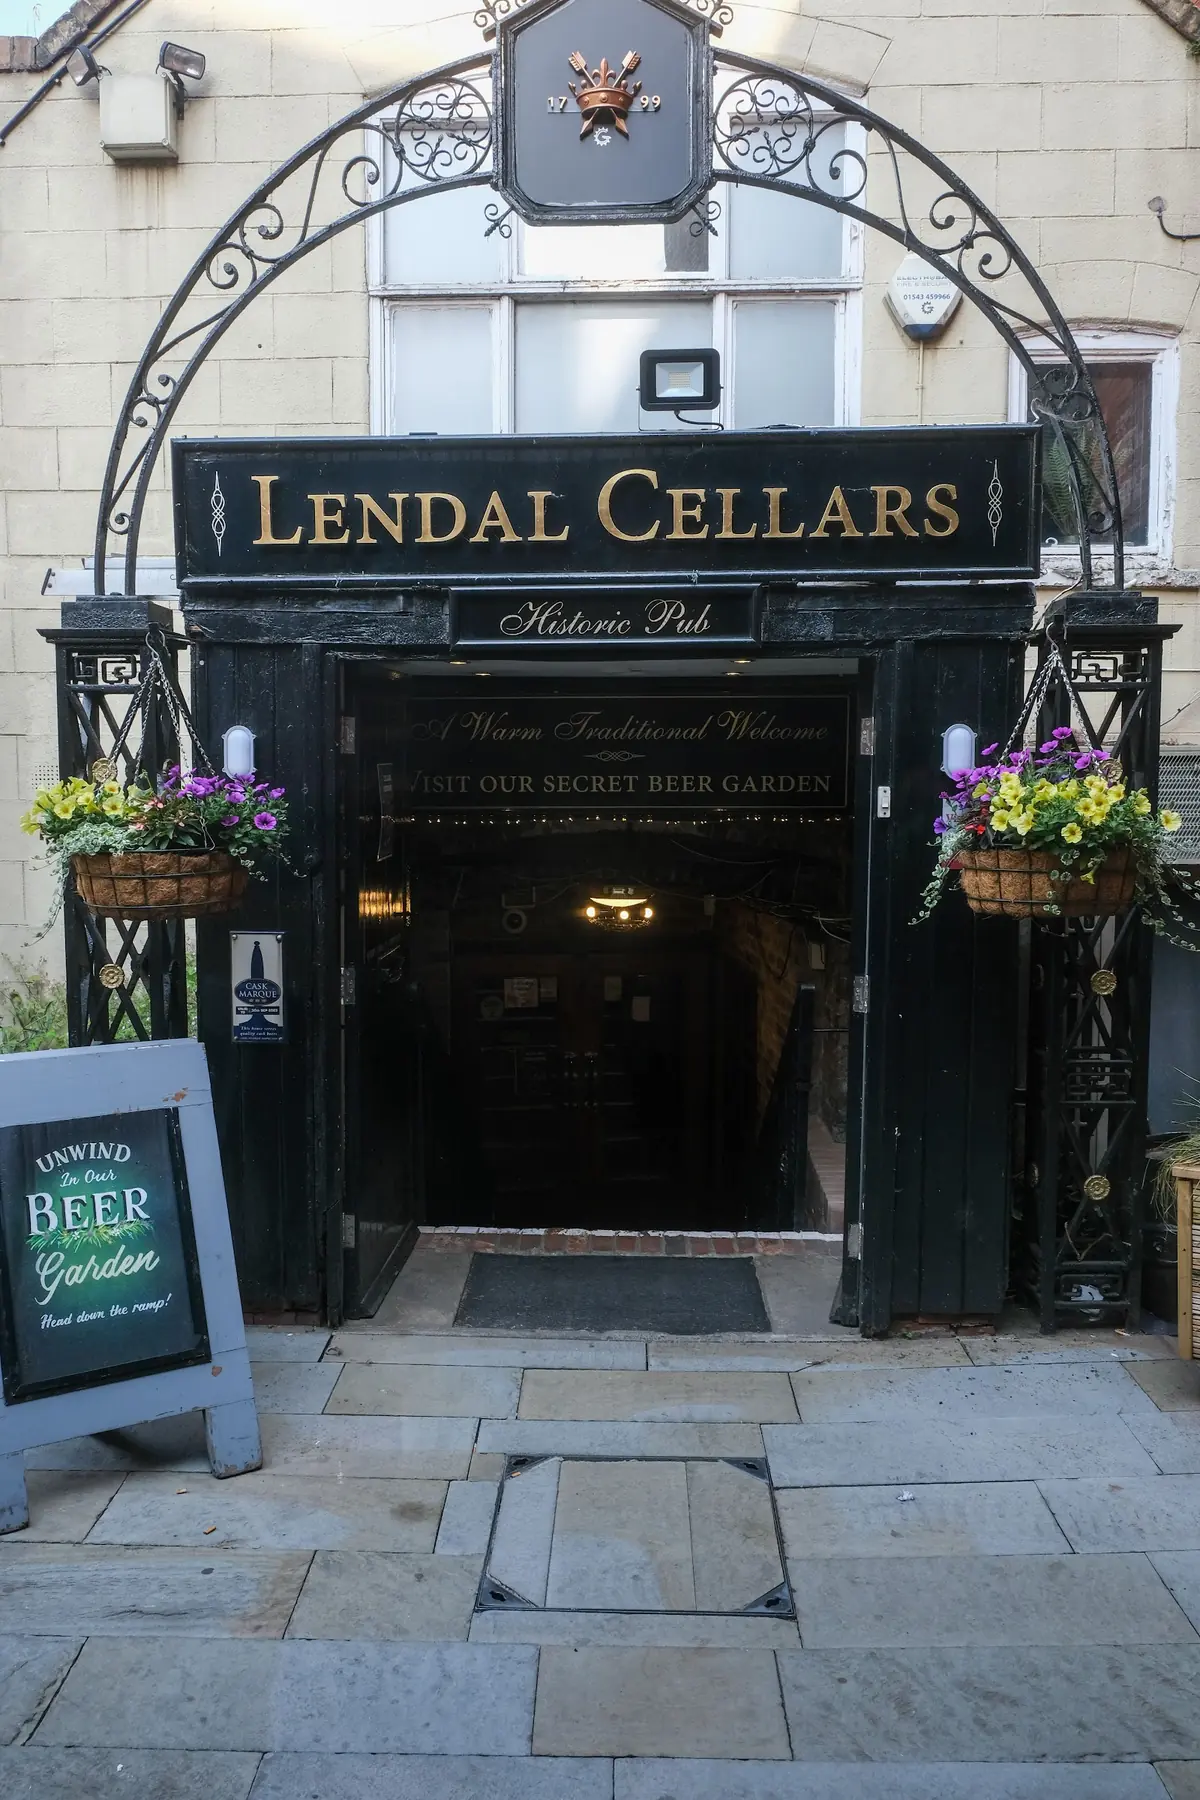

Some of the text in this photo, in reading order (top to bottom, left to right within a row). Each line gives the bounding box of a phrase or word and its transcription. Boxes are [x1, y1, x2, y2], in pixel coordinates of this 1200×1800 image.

[250, 468, 960, 545] LENDAL CELLARS
[499, 598, 712, 637] Historic Pub
[411, 709, 829, 742] A Warm Traditional Welcome
[479, 775, 535, 794] OUR
[543, 774, 640, 794] SECRET
[647, 774, 715, 794] BEER
[721, 773, 832, 794] GARDEN
[238, 990, 277, 999] MARQUE
[245, 982, 268, 990] CASK
[36, 1141, 131, 1173] UNWIND
[60, 1169, 117, 1188] In Our
[26, 1187, 151, 1236] BEER
[34, 1244, 160, 1306] Garden
[40, 1293, 172, 1330] Head down the ramp!
